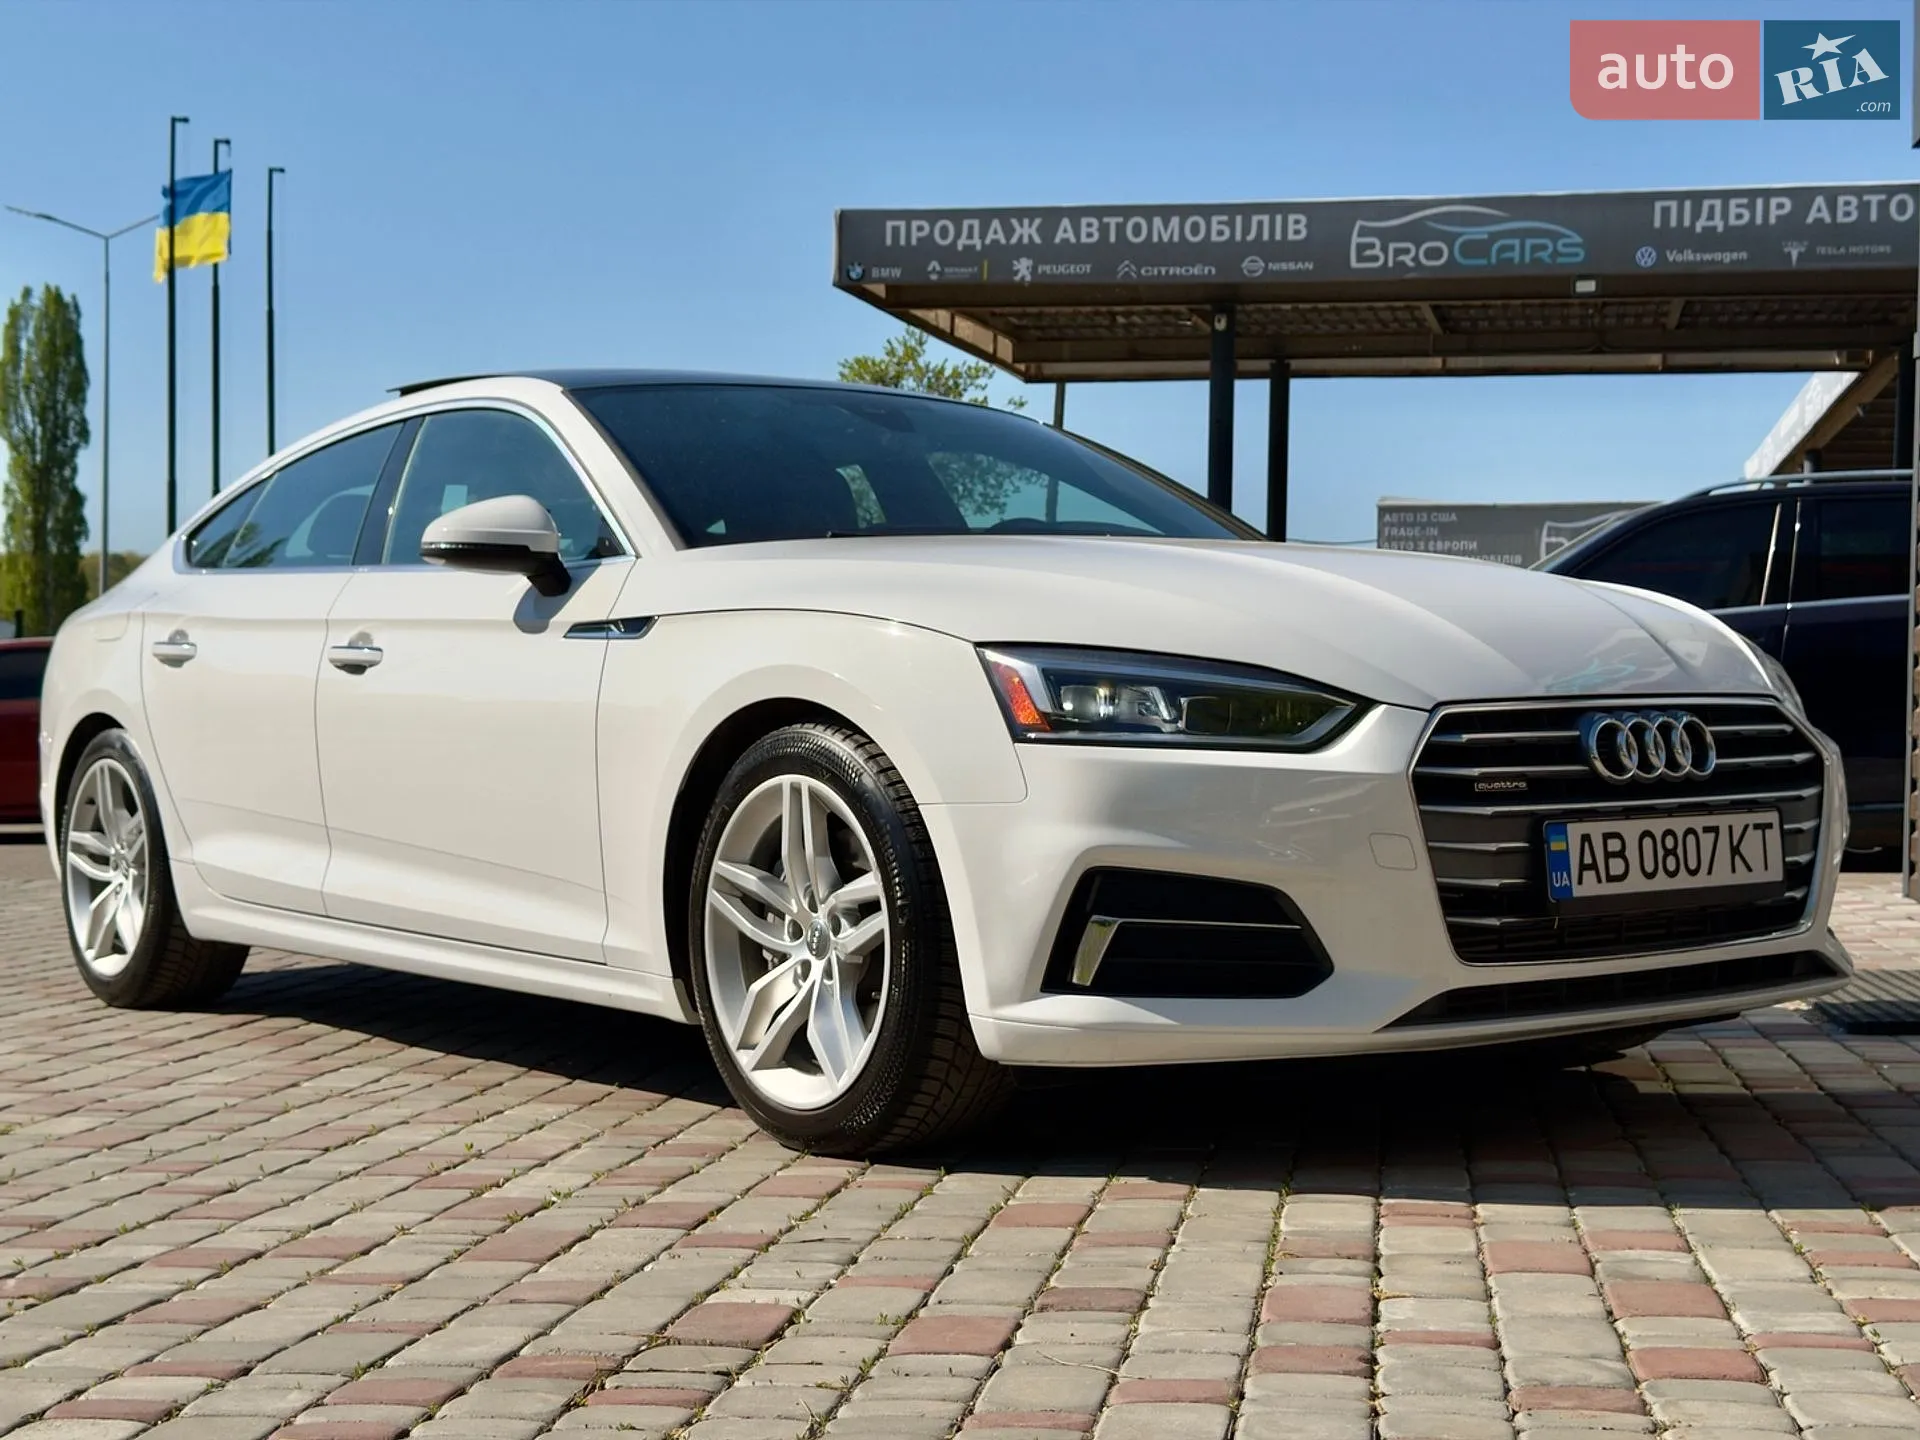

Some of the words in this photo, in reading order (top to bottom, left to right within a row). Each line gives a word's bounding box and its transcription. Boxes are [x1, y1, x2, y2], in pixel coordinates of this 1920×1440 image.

[1653, 196, 1792, 233] ПІДБІР
[1805, 193, 1915, 224] АВТО
[885, 218, 1042, 250] ПРОДАЖ
[1054, 214, 1309, 245] АВТОМОБІЛІВ
[1666, 248, 1748, 264] Volkswagen
[871, 266, 902, 279] BMW
[1038, 264, 1093, 275] PEUGEOT
[1268, 261, 1314, 271] NISSAN
[1577, 831, 1630, 885] AB
[1638, 825, 1720, 880] 0807
[1728, 822, 1774, 874] KT
[1553, 870, 1570, 887] UA
